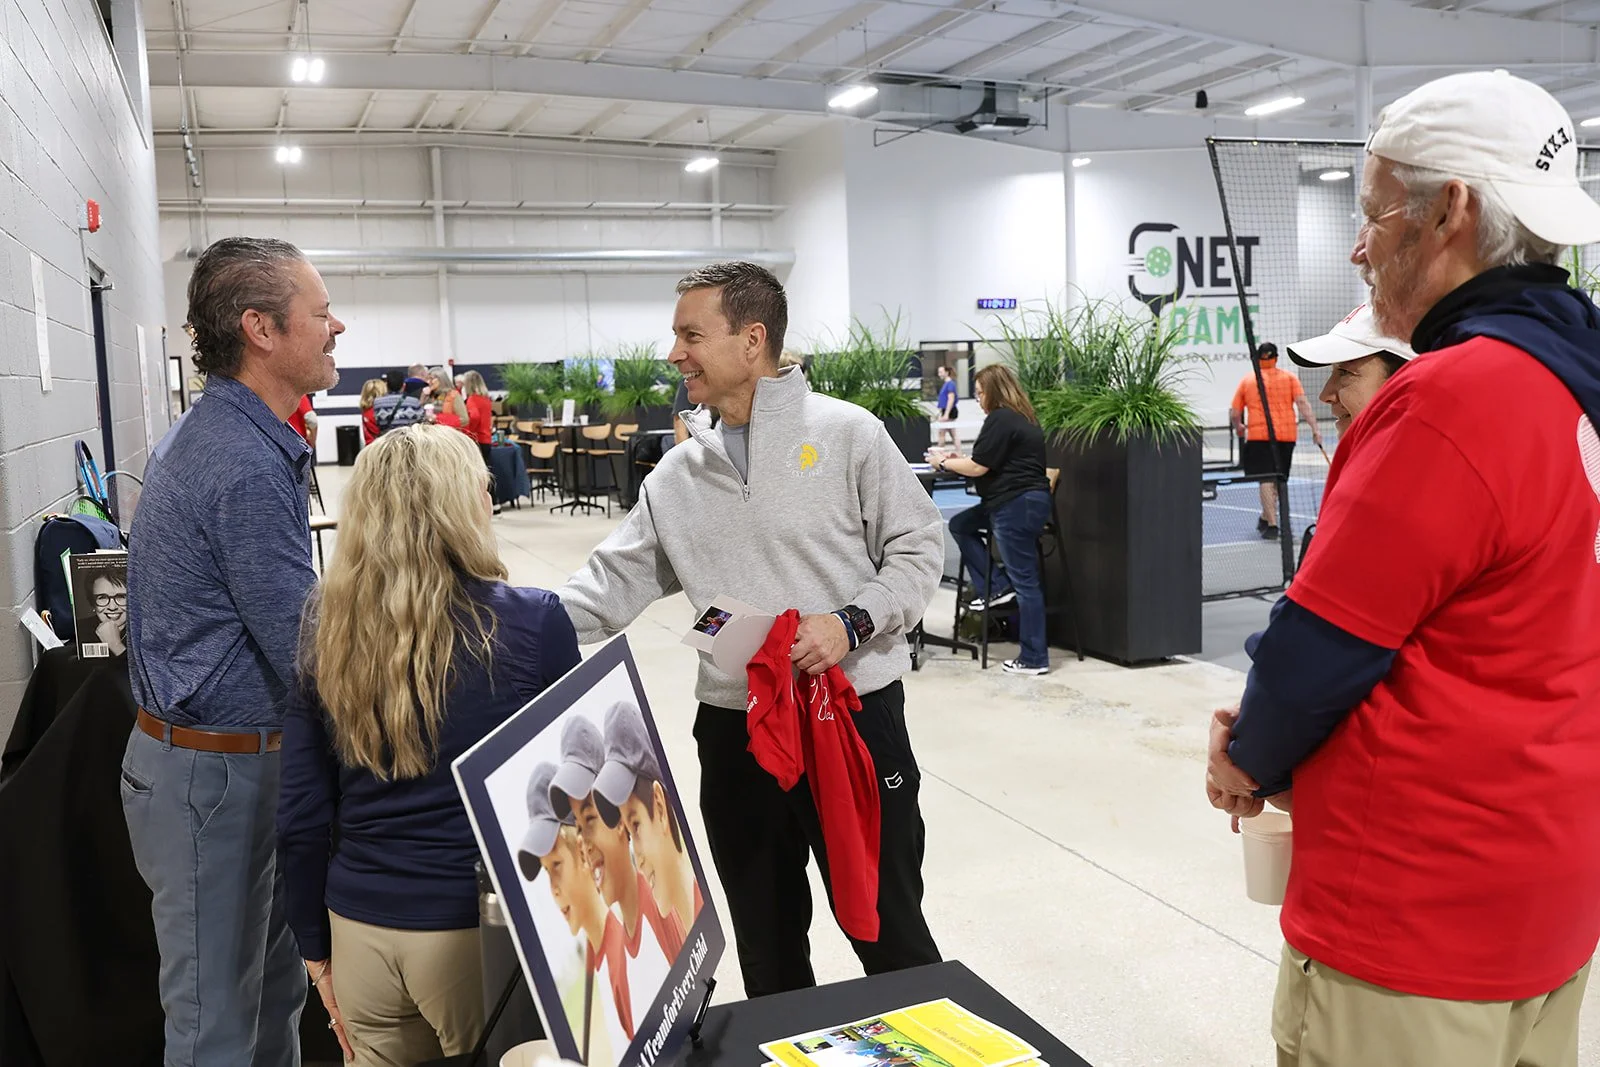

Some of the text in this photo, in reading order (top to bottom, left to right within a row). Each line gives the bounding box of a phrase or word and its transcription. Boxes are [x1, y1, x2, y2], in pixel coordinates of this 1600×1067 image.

[1535, 127, 1572, 171] EXAS
[1177, 236, 1259, 287] NET
[644, 1019, 670, 1065] Team
[663, 1003, 679, 1029] for
[673, 969, 696, 1010] Every
[689, 932, 708, 975] Child
